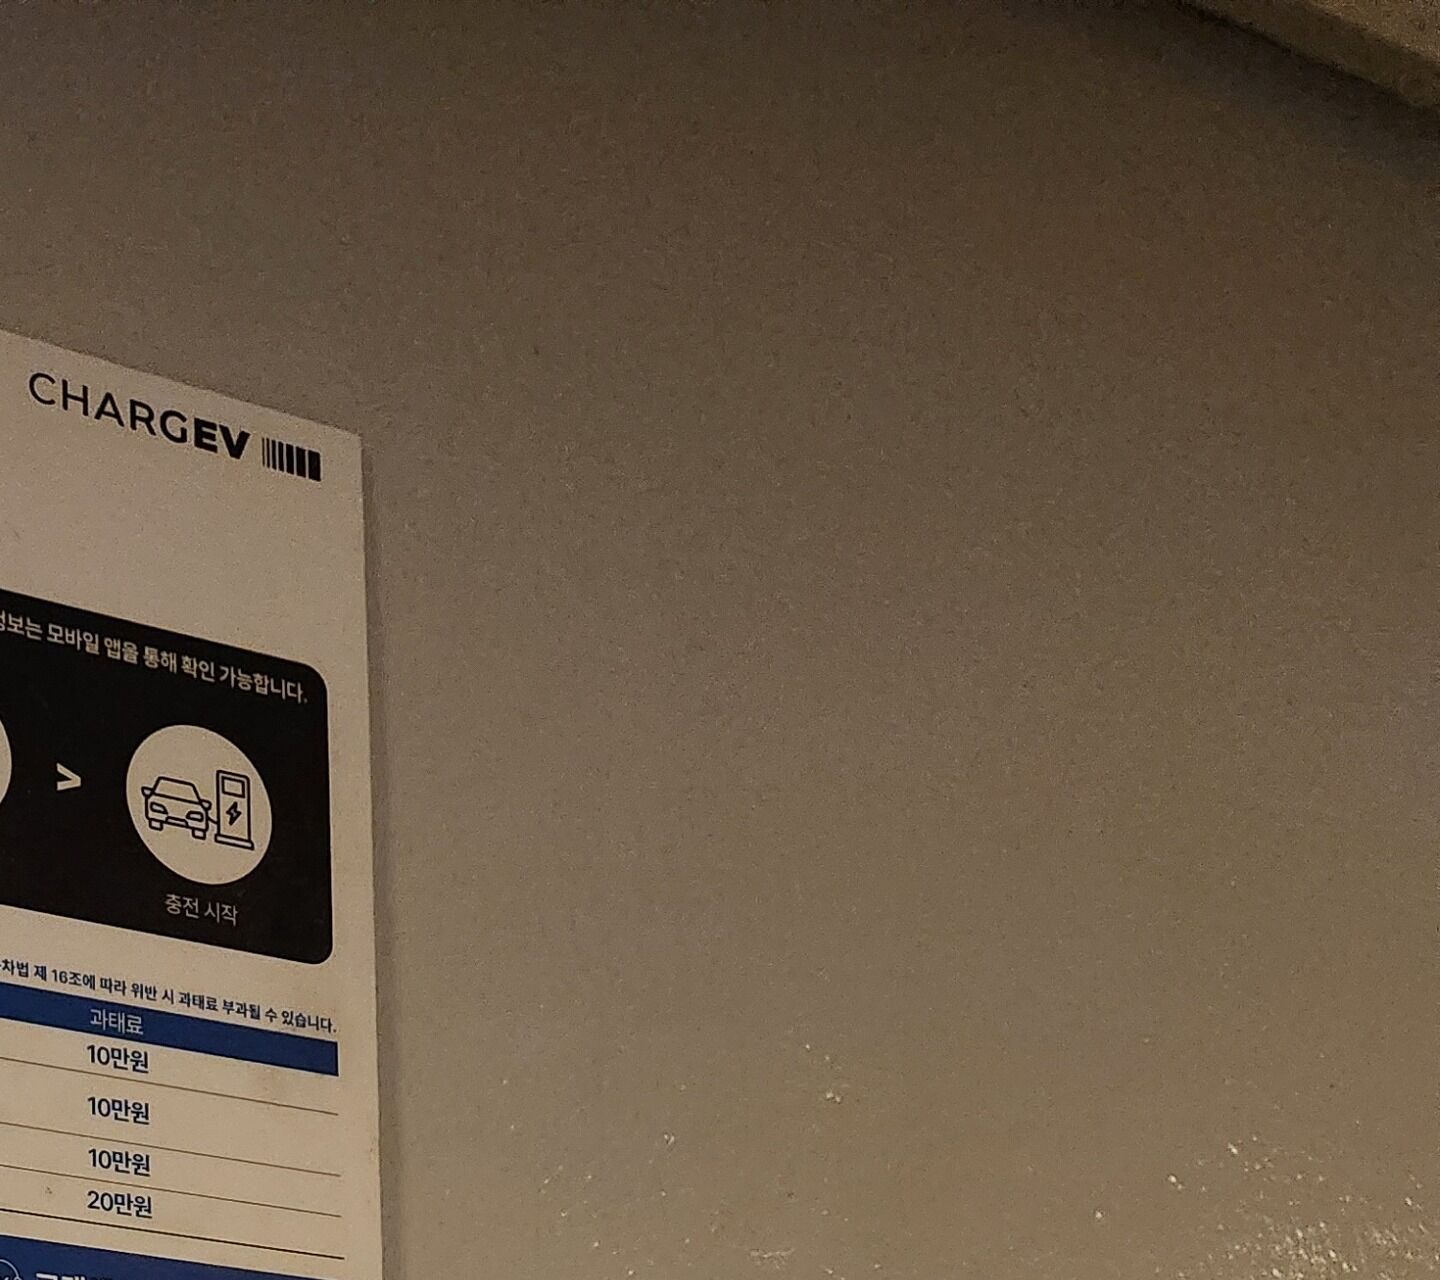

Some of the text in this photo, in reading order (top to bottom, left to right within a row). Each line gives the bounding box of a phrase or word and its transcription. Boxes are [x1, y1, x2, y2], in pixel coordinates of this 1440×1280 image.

[28, 372, 251, 460] CHARGEV
[46, 623, 100, 655] 모바일
[103, 636, 140, 665] 앱을
[143, 646, 177, 674] 통해
[181, 654, 216, 682] 확인
[220, 666, 308, 704] 가능합니다.
[164, 892, 238, 927] 충전 시작
[33, 964, 48, 982] 제
[51, 968, 97, 991] 16조에
[100, 975, 128, 997] 따라
[130, 980, 158, 1002] 위반
[161, 987, 176, 1006] 시
[178, 988, 218, 1013] 과태료
[222, 996, 261, 1021] 부과될
[264, 1005, 279, 1024] 수
[281, 1008, 338, 1034] 있습니다.
[89, 1008, 144, 1036] 과태료
[86, 1044, 150, 1075] 10만원
[87, 1096, 151, 1126] 10만원
[87, 1148, 152, 1178] 10만원
[87, 1191, 153, 1221] 20만원
